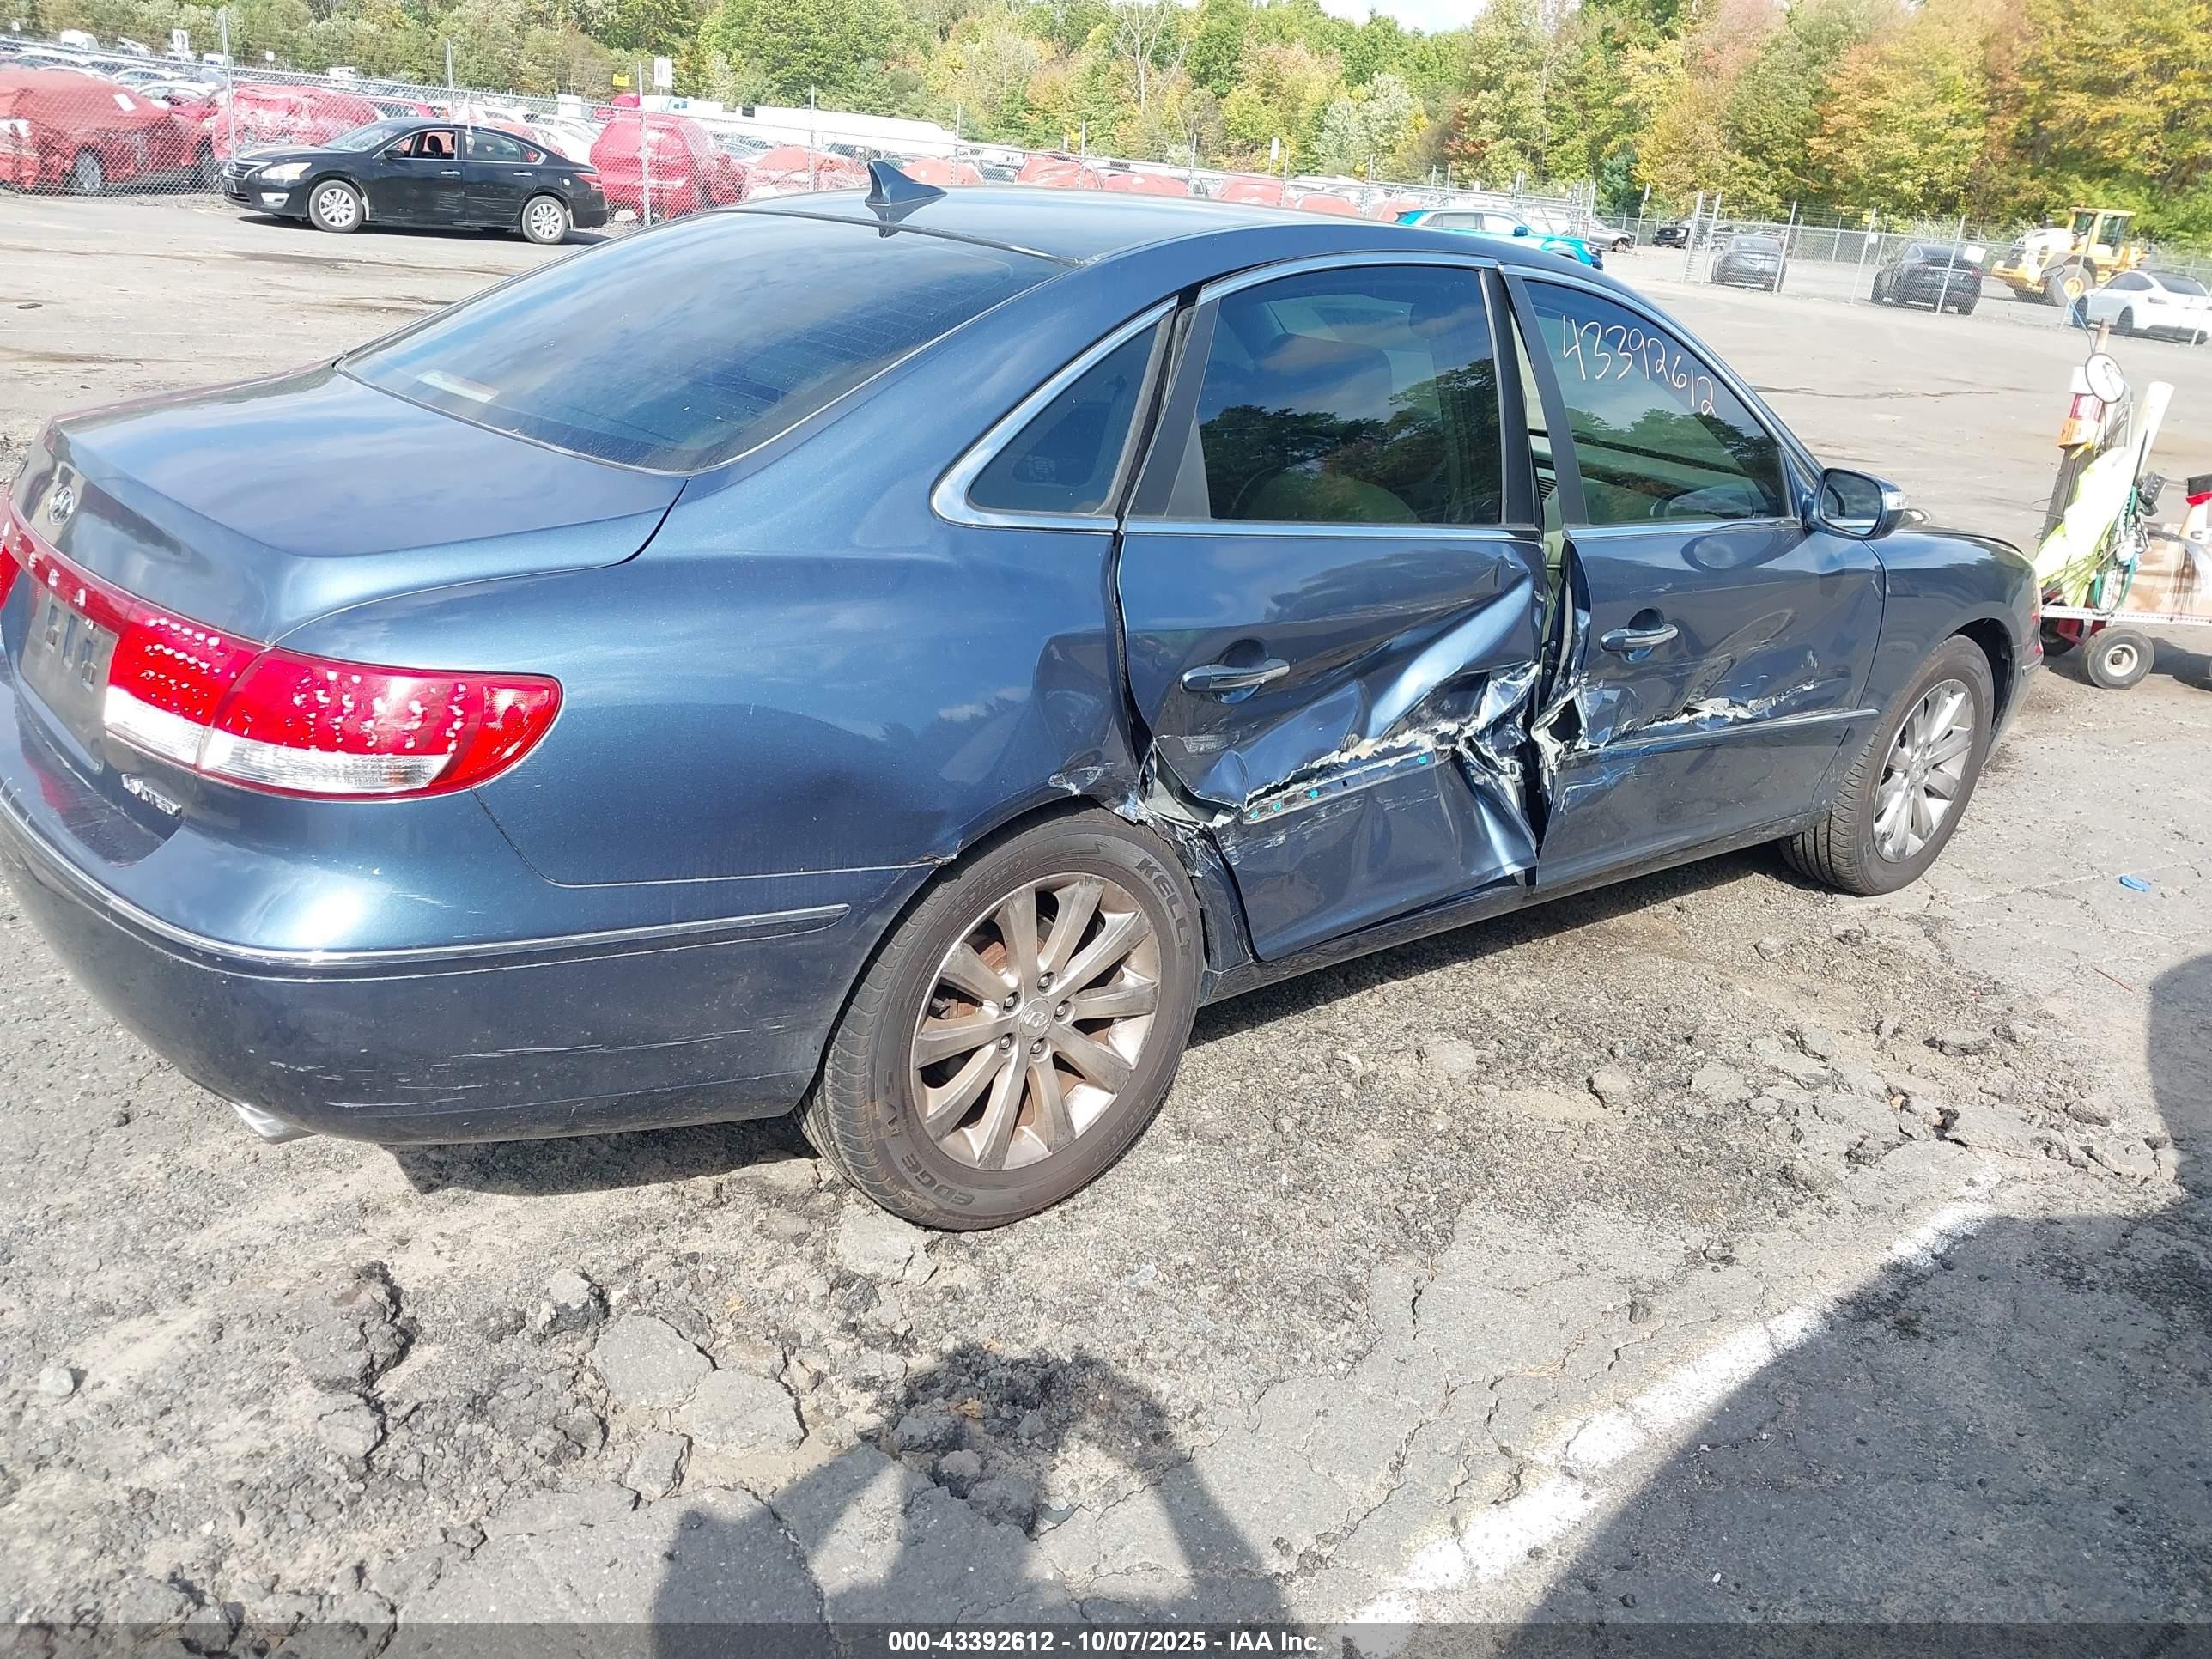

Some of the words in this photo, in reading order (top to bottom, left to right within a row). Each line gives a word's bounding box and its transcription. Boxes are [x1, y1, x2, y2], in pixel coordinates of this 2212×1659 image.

[1562, 314, 1717, 416] 43392612
[1134, 857, 1192, 957] KELLY
[901, 1152, 975, 1207] EDGE
